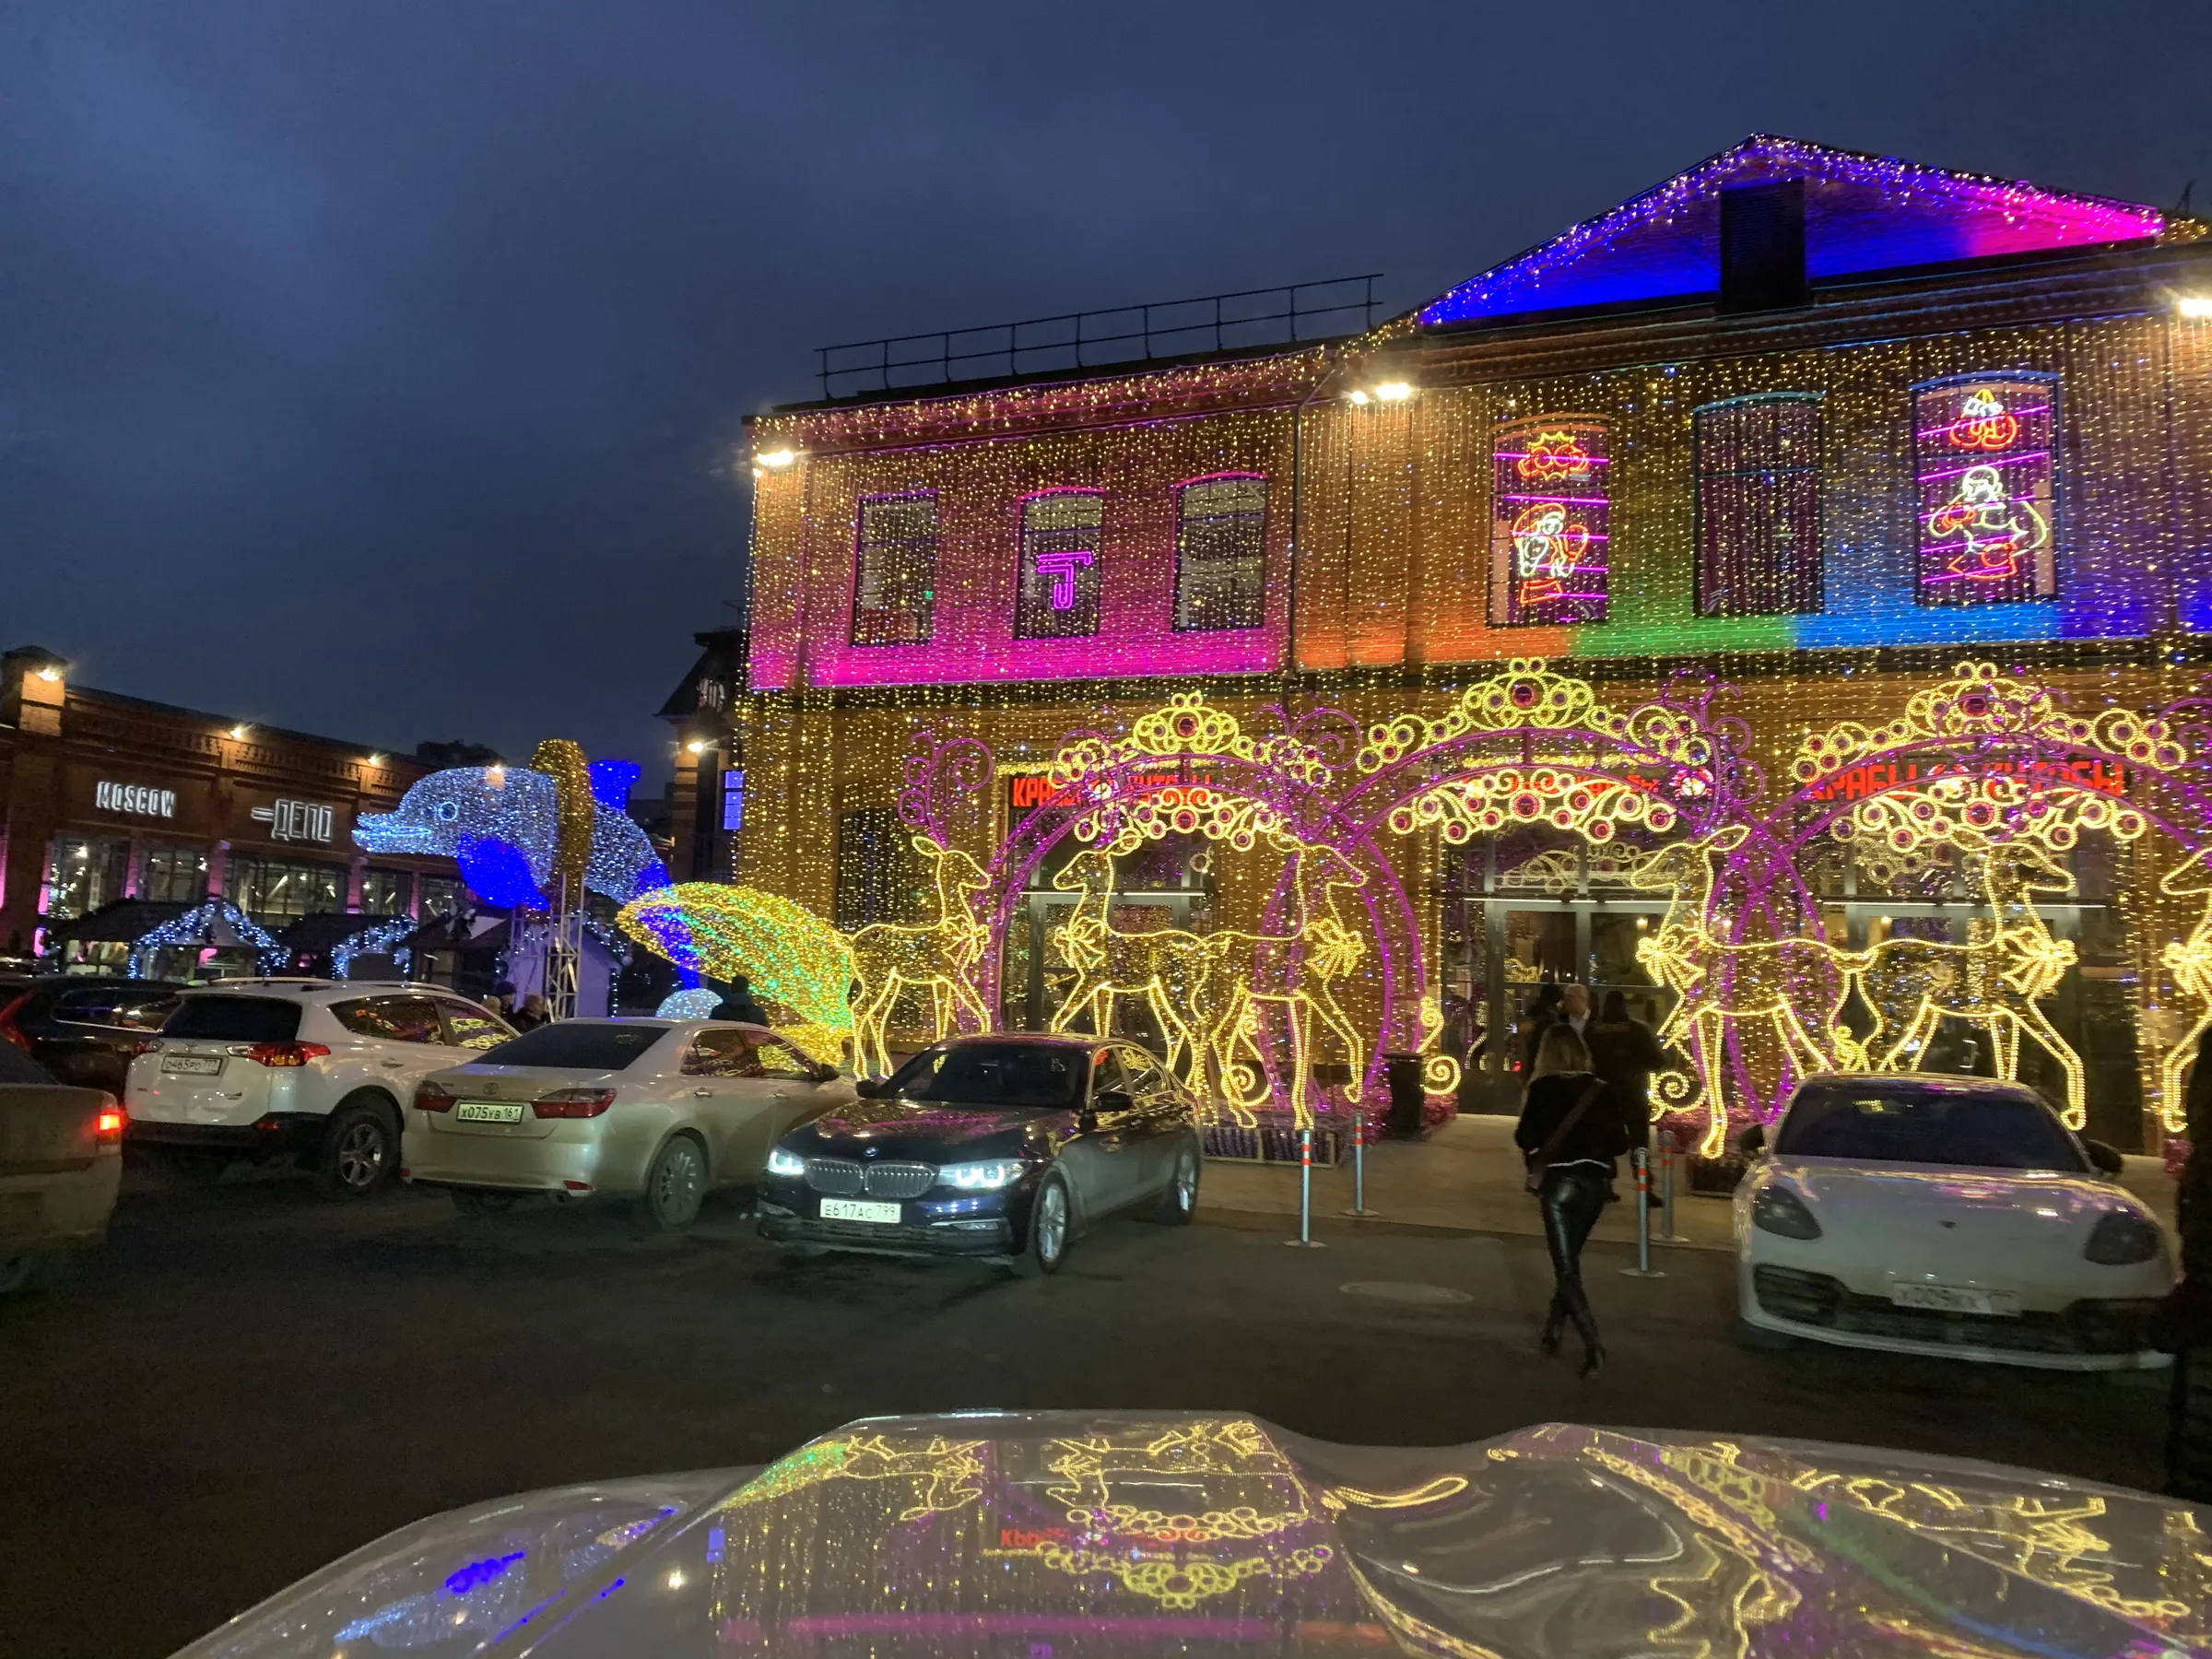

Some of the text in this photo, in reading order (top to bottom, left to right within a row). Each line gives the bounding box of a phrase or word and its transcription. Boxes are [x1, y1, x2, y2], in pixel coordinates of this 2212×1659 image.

[96, 782, 175, 818] MOSCOW
[271, 799, 334, 842] ДЕПО
[503, 1107, 519, 1118] 161
[876, 1204, 896, 1218] 799
